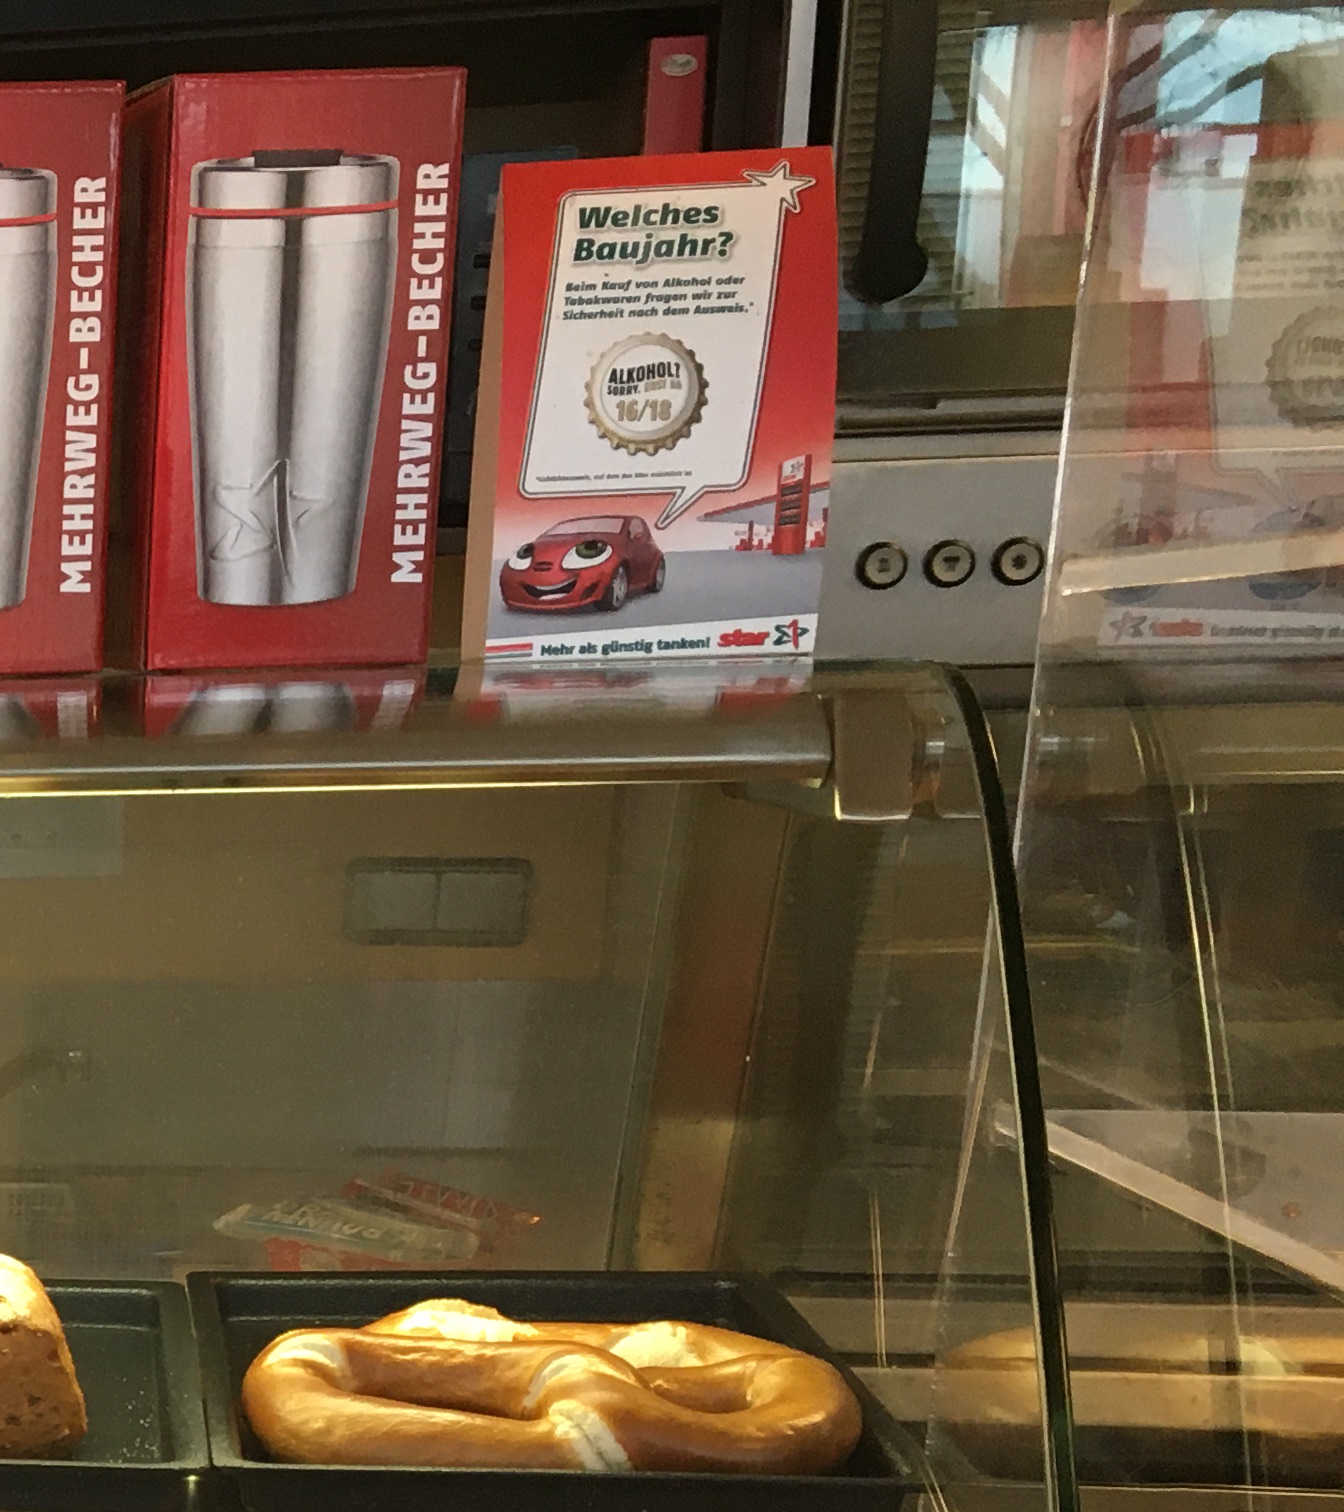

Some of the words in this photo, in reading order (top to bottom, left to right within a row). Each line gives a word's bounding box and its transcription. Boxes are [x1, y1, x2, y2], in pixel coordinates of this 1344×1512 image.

[578, 203, 719, 229] Welches
[573, 231, 734, 265] Baujahr?
[566, 283, 597, 292] Beim
[602, 280, 632, 292] Kauf
[635, 281, 658, 289] von
[663, 277, 711, 288] Alkohol
[716, 276, 745, 285] oder
[564, 295, 641, 306] Tabakwaren
[644, 293, 687, 304] fragen
[692, 291, 713, 300] wir
[716, 291, 738, 300] zur
[563, 309, 624, 320] Sicherheit
[628, 307, 658, 317] nach
[662, 306, 689, 316] dem
[390, 161, 450, 584] MEHRWEG-BECHER
[608, 362, 680, 384] ALKOHOL?
[59, 176, 108, 594] MEHRWEG-BECHER
[616, 399, 672, 422] 16/18
[540, 643, 574, 656] Mehr
[579, 642, 598, 654] als
[602, 639, 652, 656] günstig
[657, 636, 710, 651] tanken!
[717, 628, 770, 648] star
